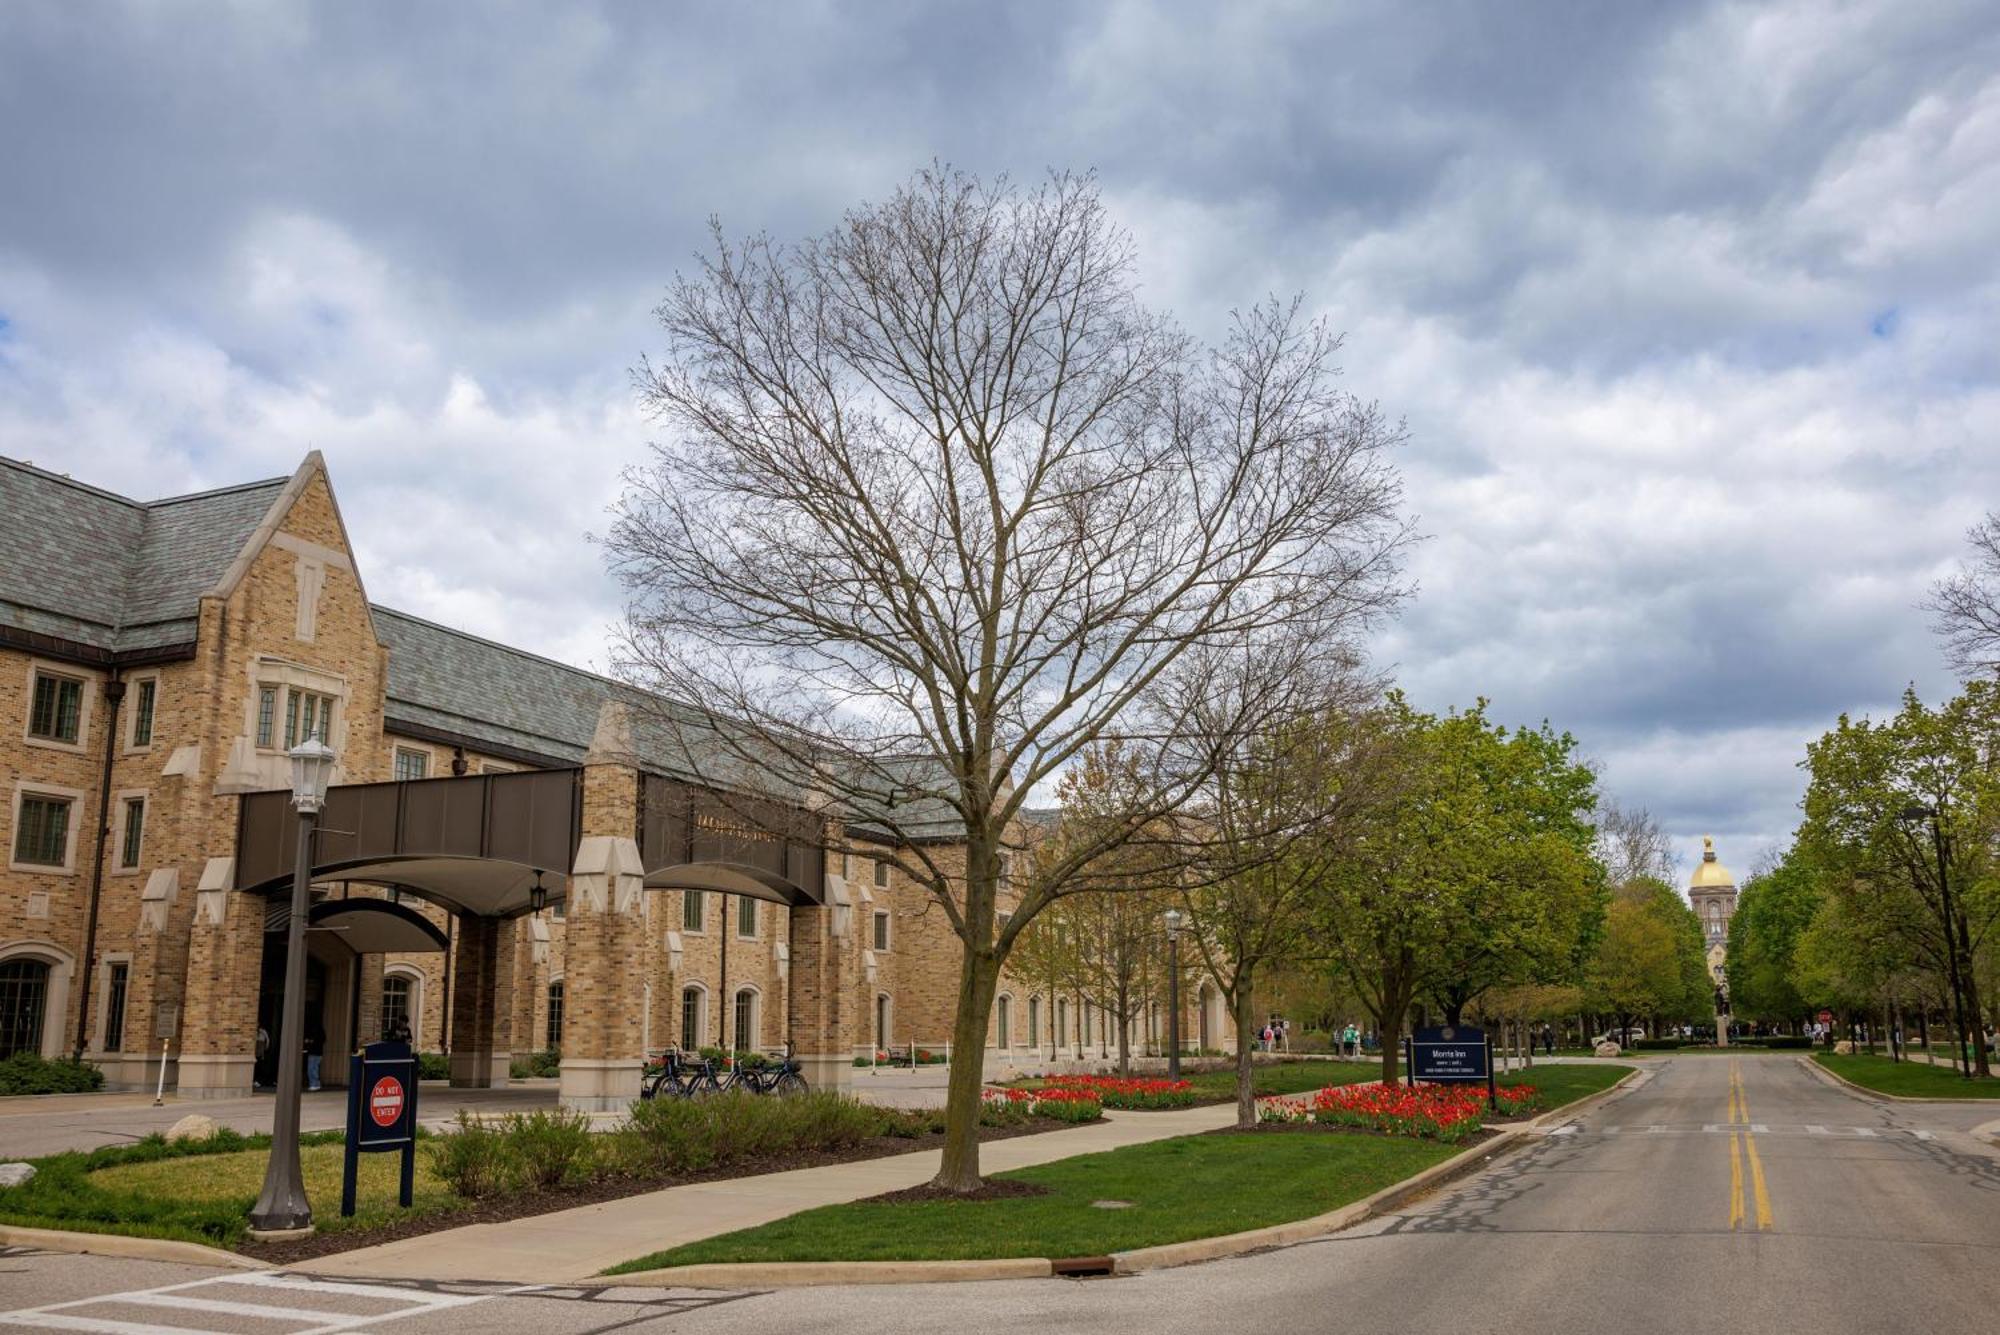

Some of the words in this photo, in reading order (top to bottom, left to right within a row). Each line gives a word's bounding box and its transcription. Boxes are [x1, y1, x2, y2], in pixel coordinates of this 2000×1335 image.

[1432, 1049, 1454, 1058] Morris
[1455, 1049, 1466, 1058] Inn
[376, 1087, 384, 1096] DO
[387, 1087, 398, 1095] NOT
[376, 1108, 395, 1116] ENTER
